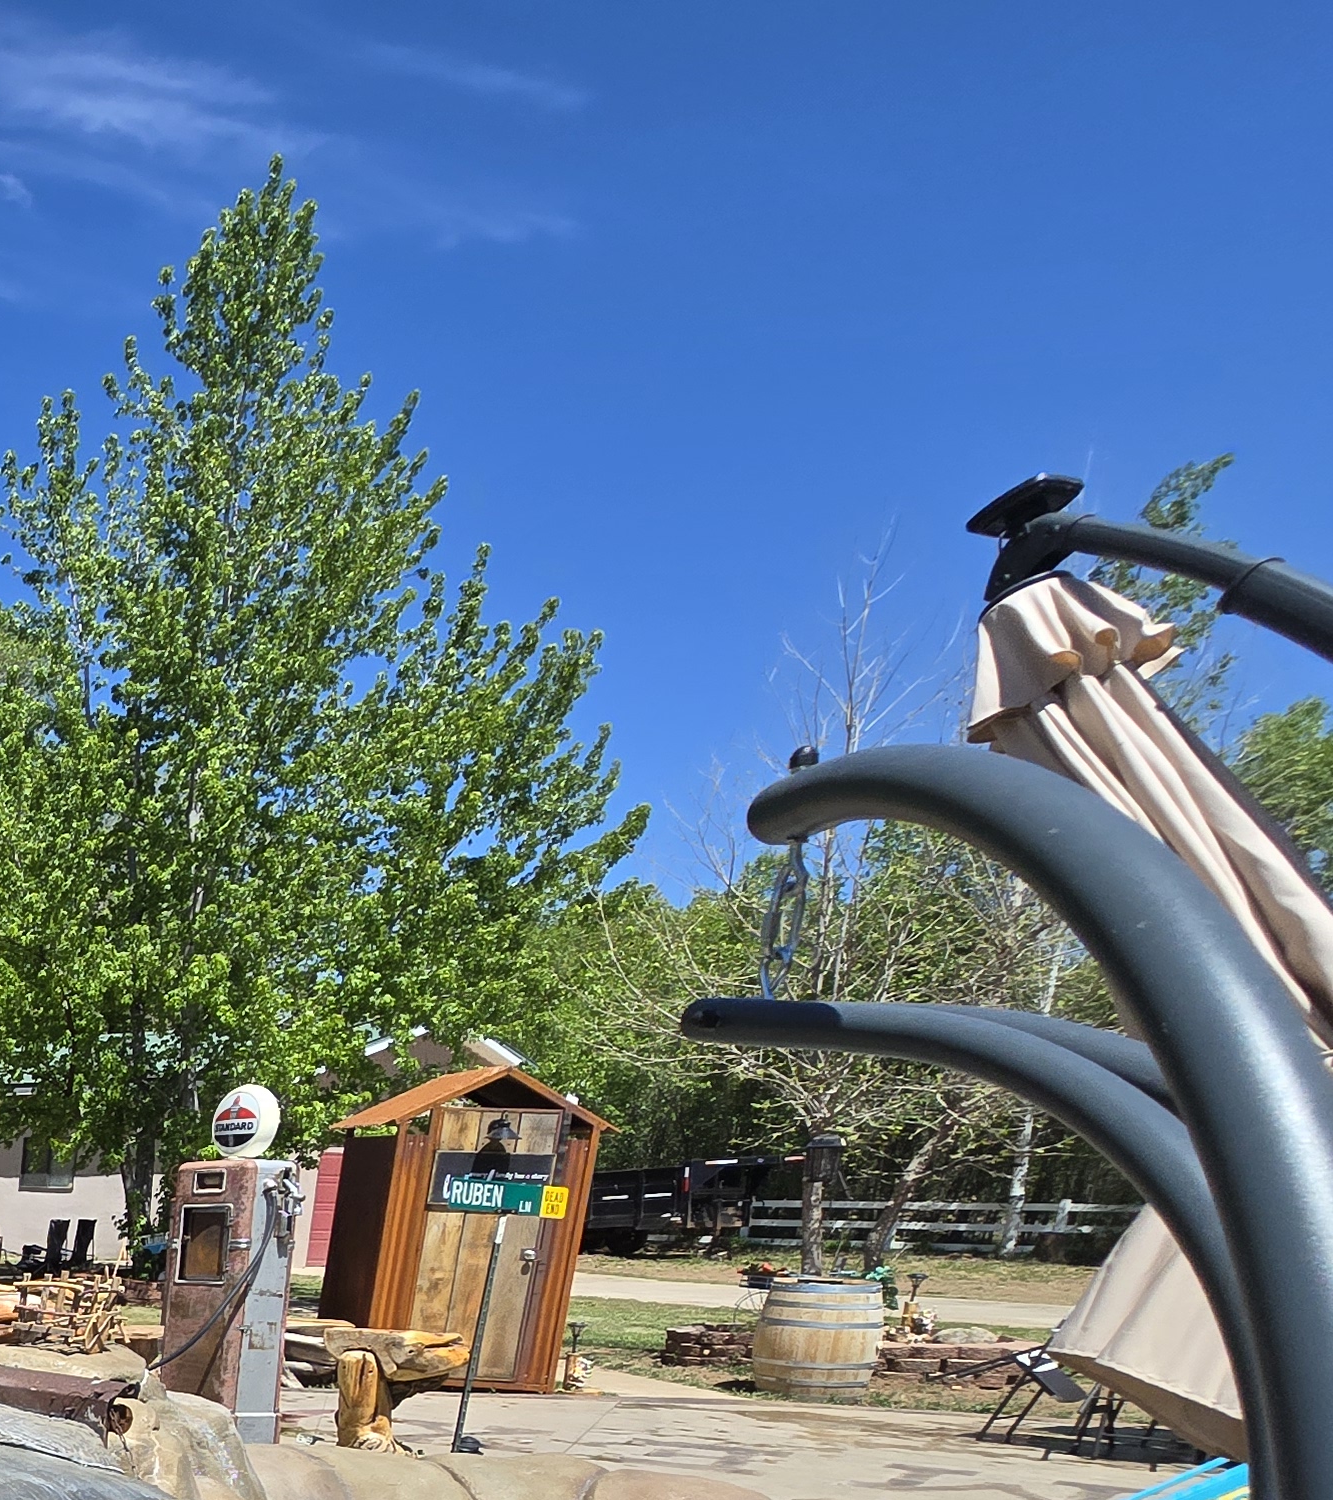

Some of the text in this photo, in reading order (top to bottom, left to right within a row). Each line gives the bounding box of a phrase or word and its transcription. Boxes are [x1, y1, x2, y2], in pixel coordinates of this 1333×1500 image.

[215, 1122, 253, 1132] STANDARD
[451, 1181, 504, 1207] RUBEN
[519, 1201, 531, 1212] LN
[545, 1191, 564, 1203] DEAD
[546, 1203, 559, 1214] END
